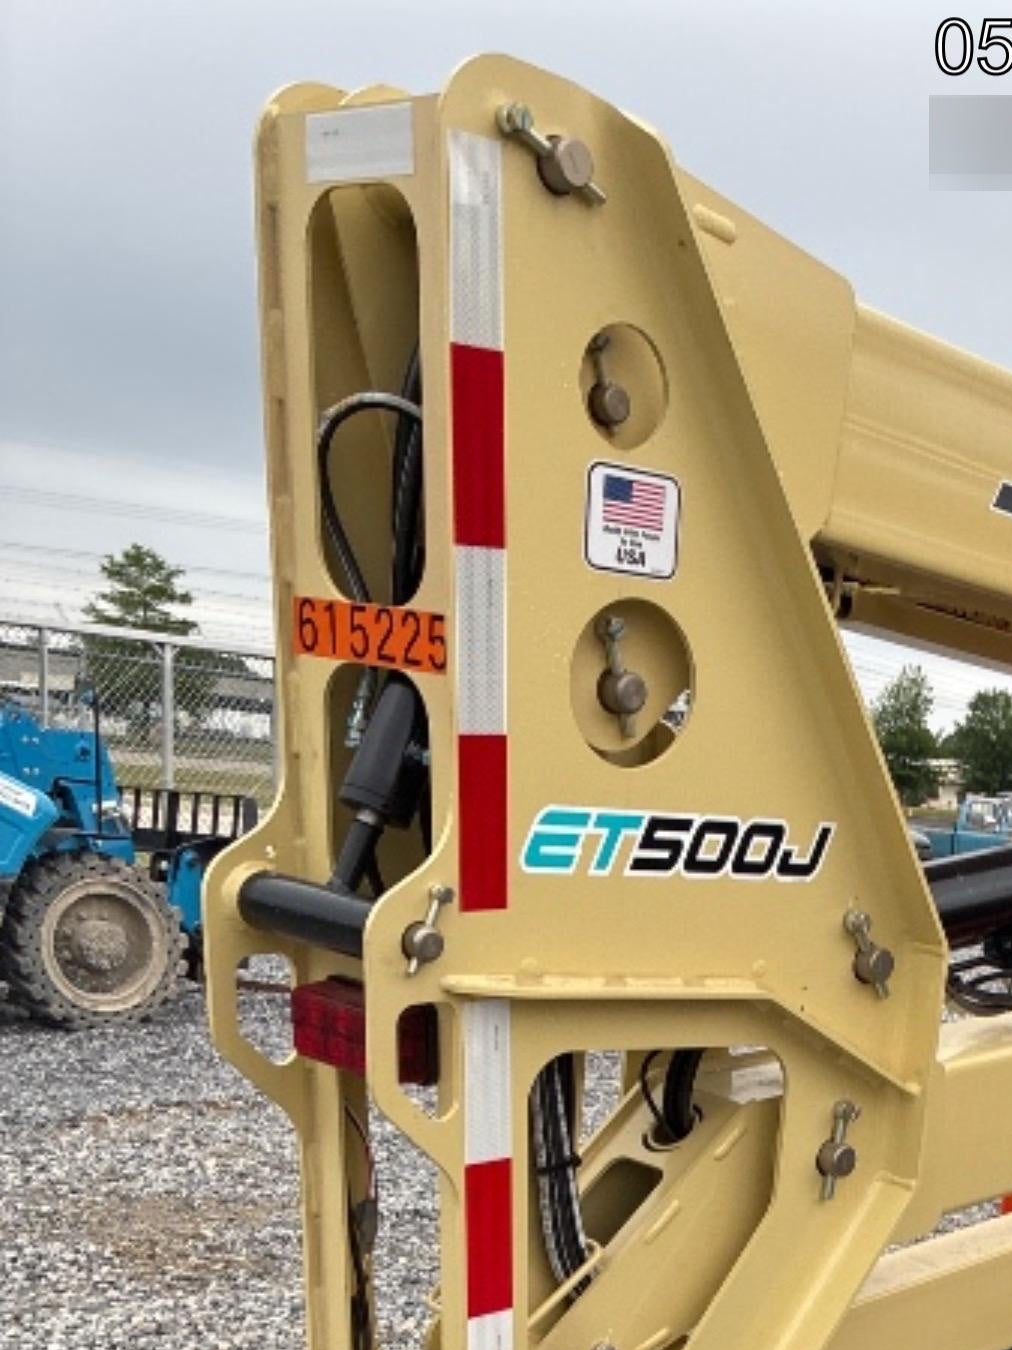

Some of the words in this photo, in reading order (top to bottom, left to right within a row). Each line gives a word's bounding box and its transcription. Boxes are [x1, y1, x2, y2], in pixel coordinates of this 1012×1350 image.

[616, 547, 646, 567] USA
[299, 598, 447, 671] 615225
[521, 805, 836, 880] ET500J
